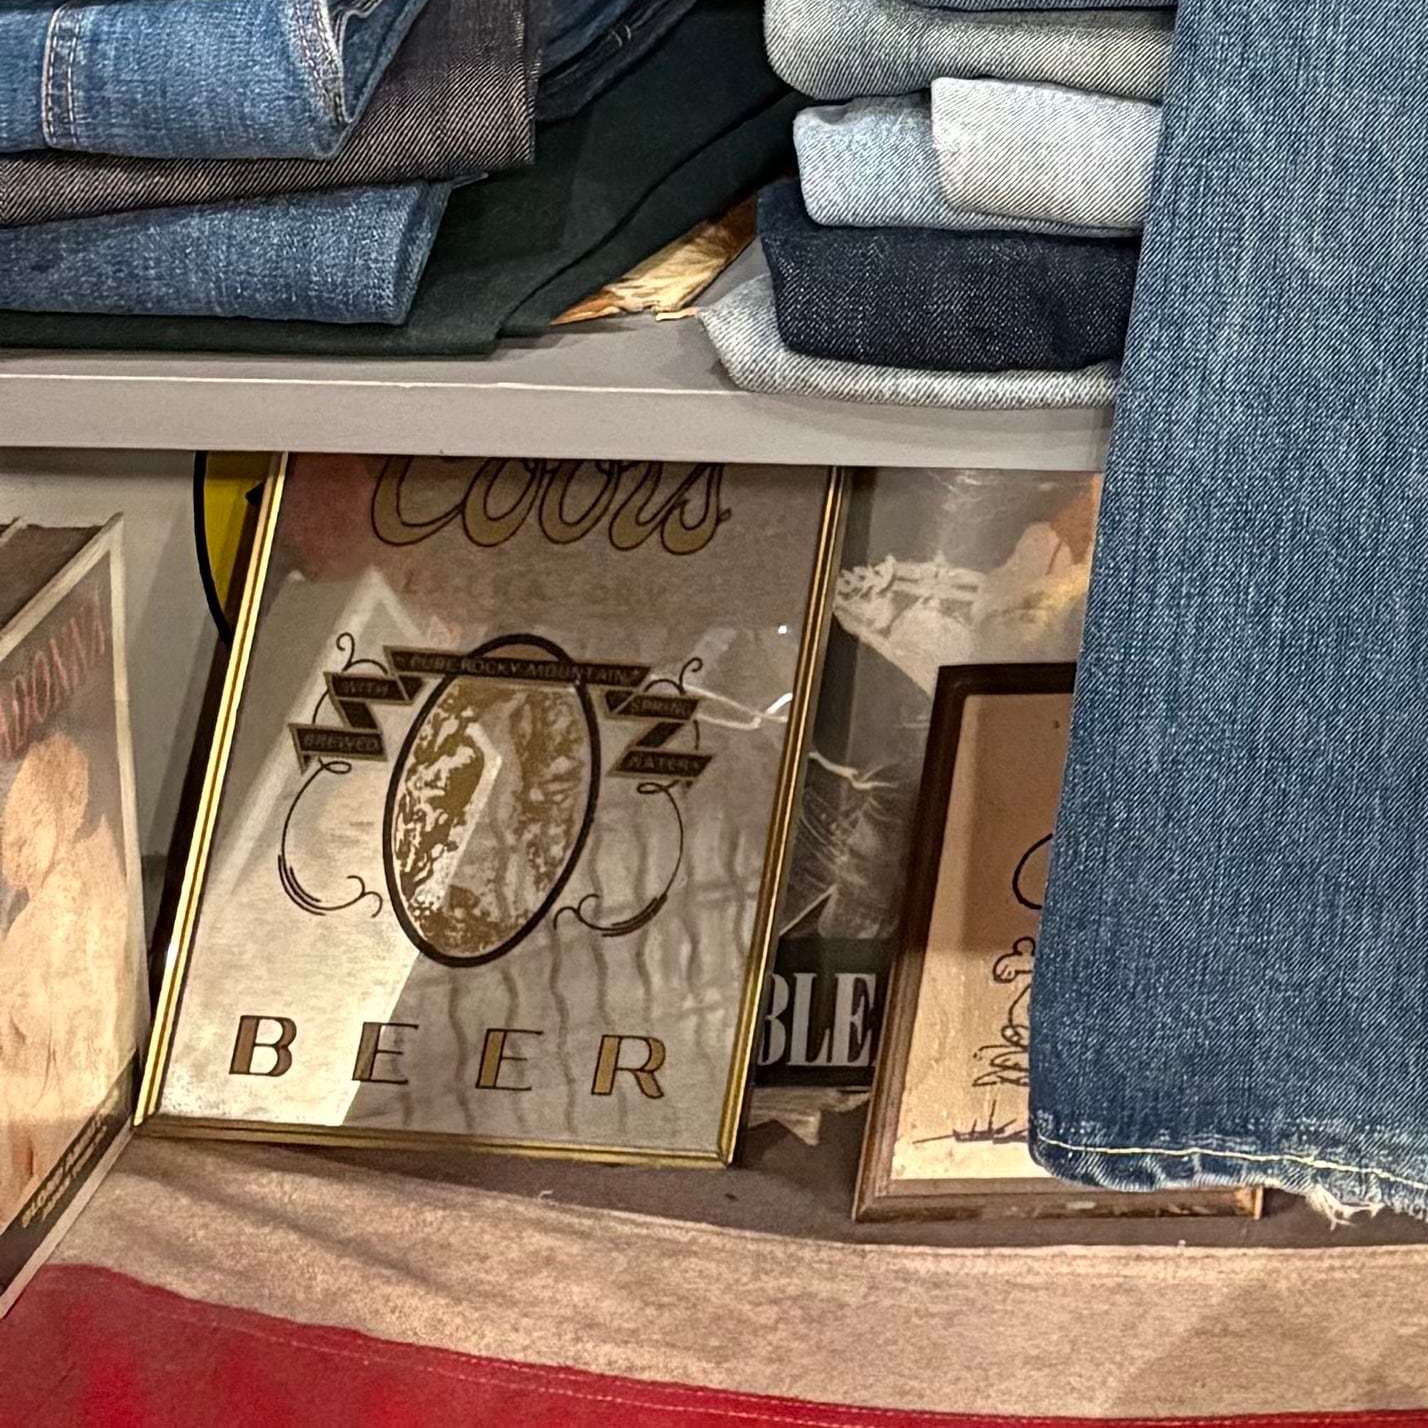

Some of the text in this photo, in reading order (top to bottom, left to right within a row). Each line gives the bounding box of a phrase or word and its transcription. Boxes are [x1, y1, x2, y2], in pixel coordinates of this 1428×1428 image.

[461, 657, 518, 675] ROCKY
[526, 662, 626, 683] MOUNTAIN
[229, 1014, 666, 1099] BEER
